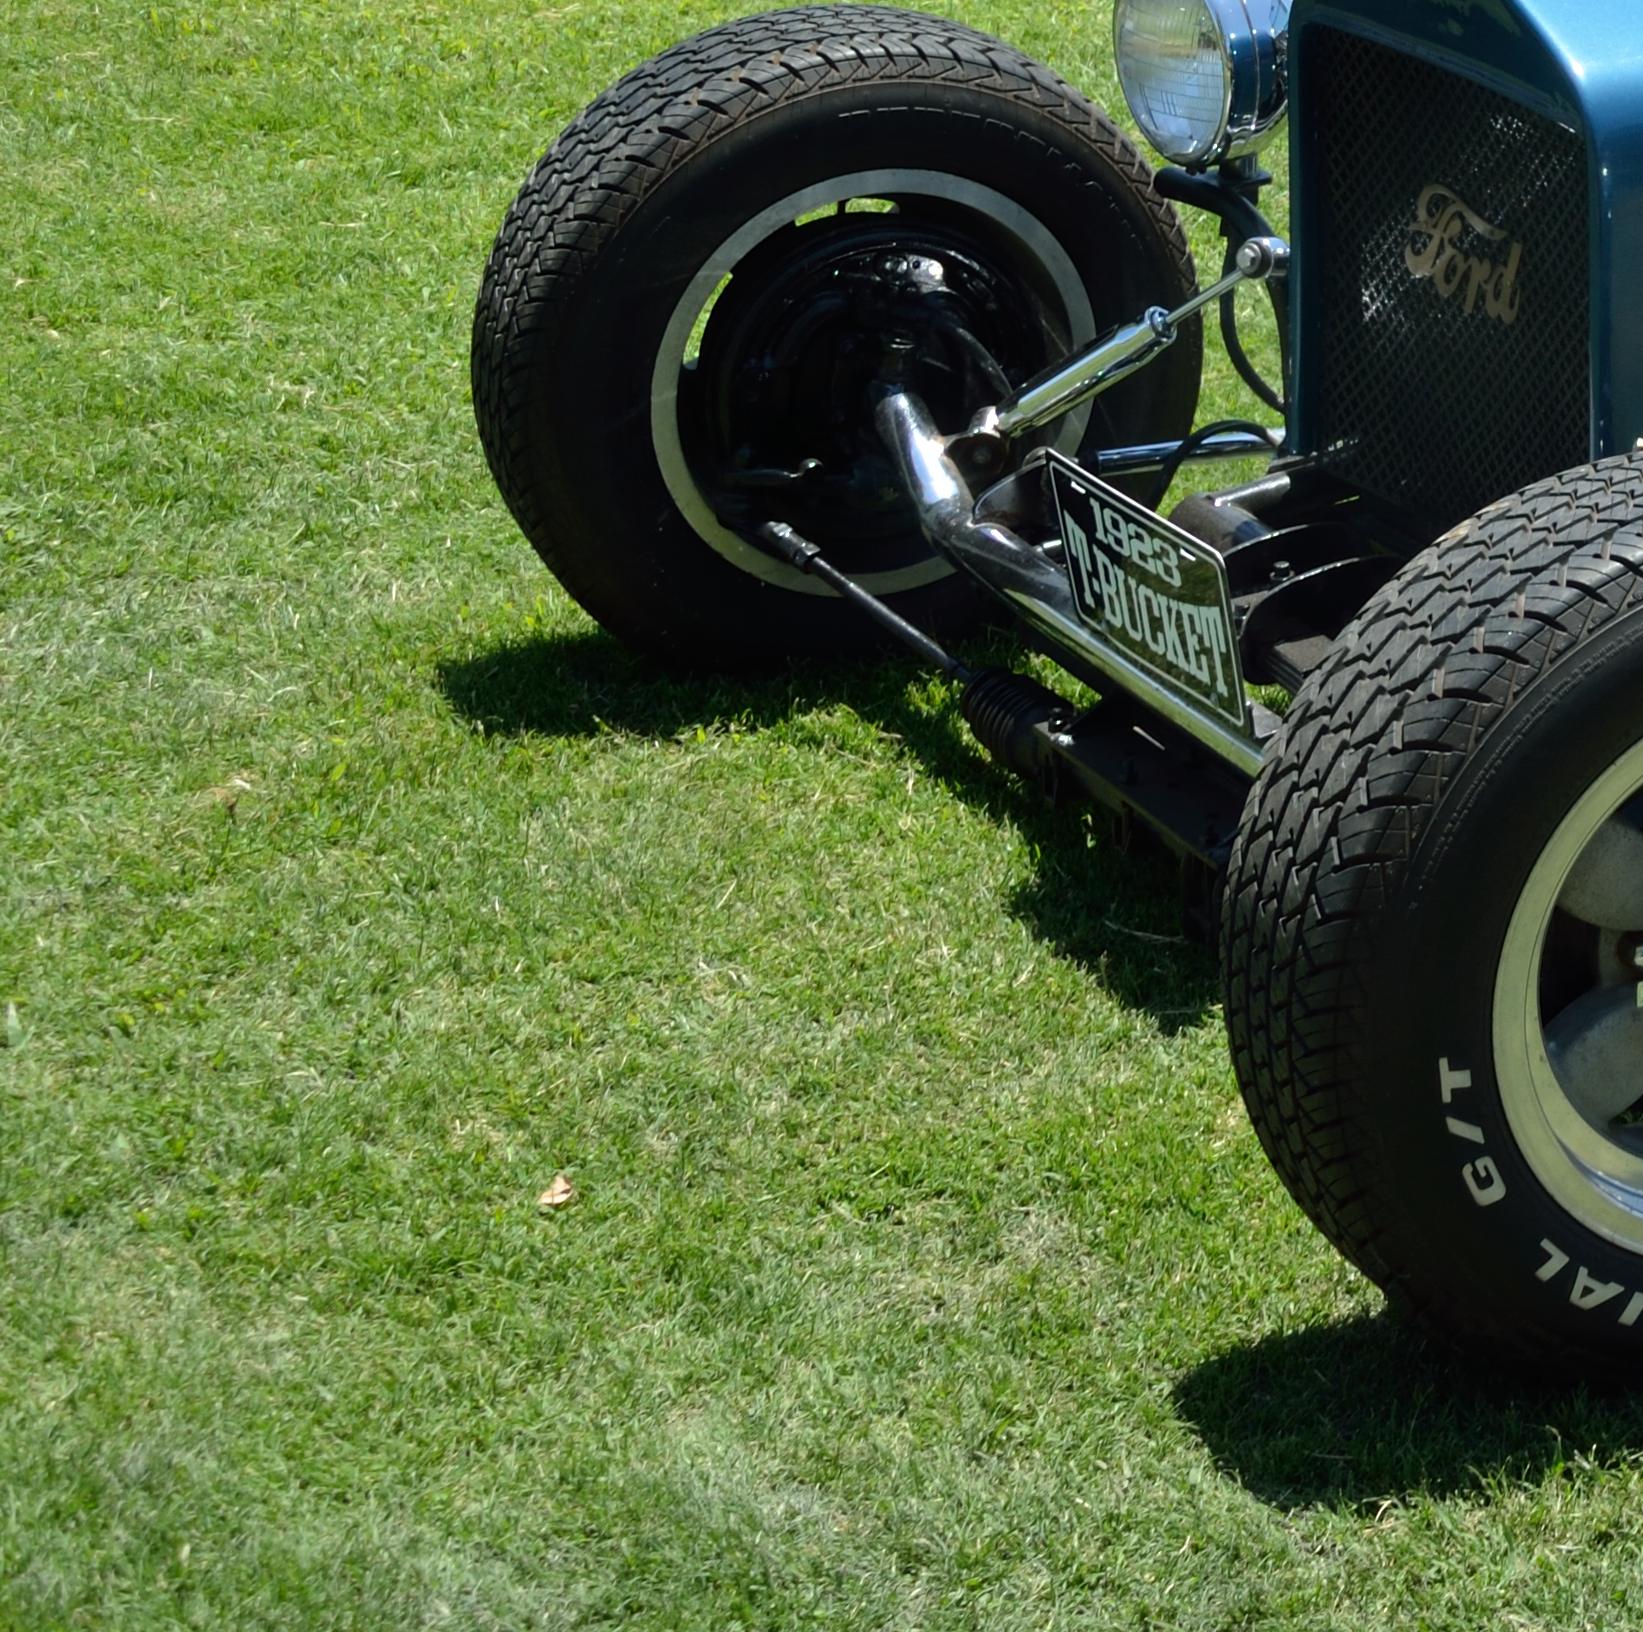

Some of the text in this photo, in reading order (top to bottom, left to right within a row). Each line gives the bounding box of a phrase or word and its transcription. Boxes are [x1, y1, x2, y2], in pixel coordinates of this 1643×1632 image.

[1404, 183, 1523, 325] Ford
[1063, 509, 1229, 697] T-BUCKET
[1089, 497, 1182, 587] 1923
[1438, 1056, 1507, 1207] G/T
